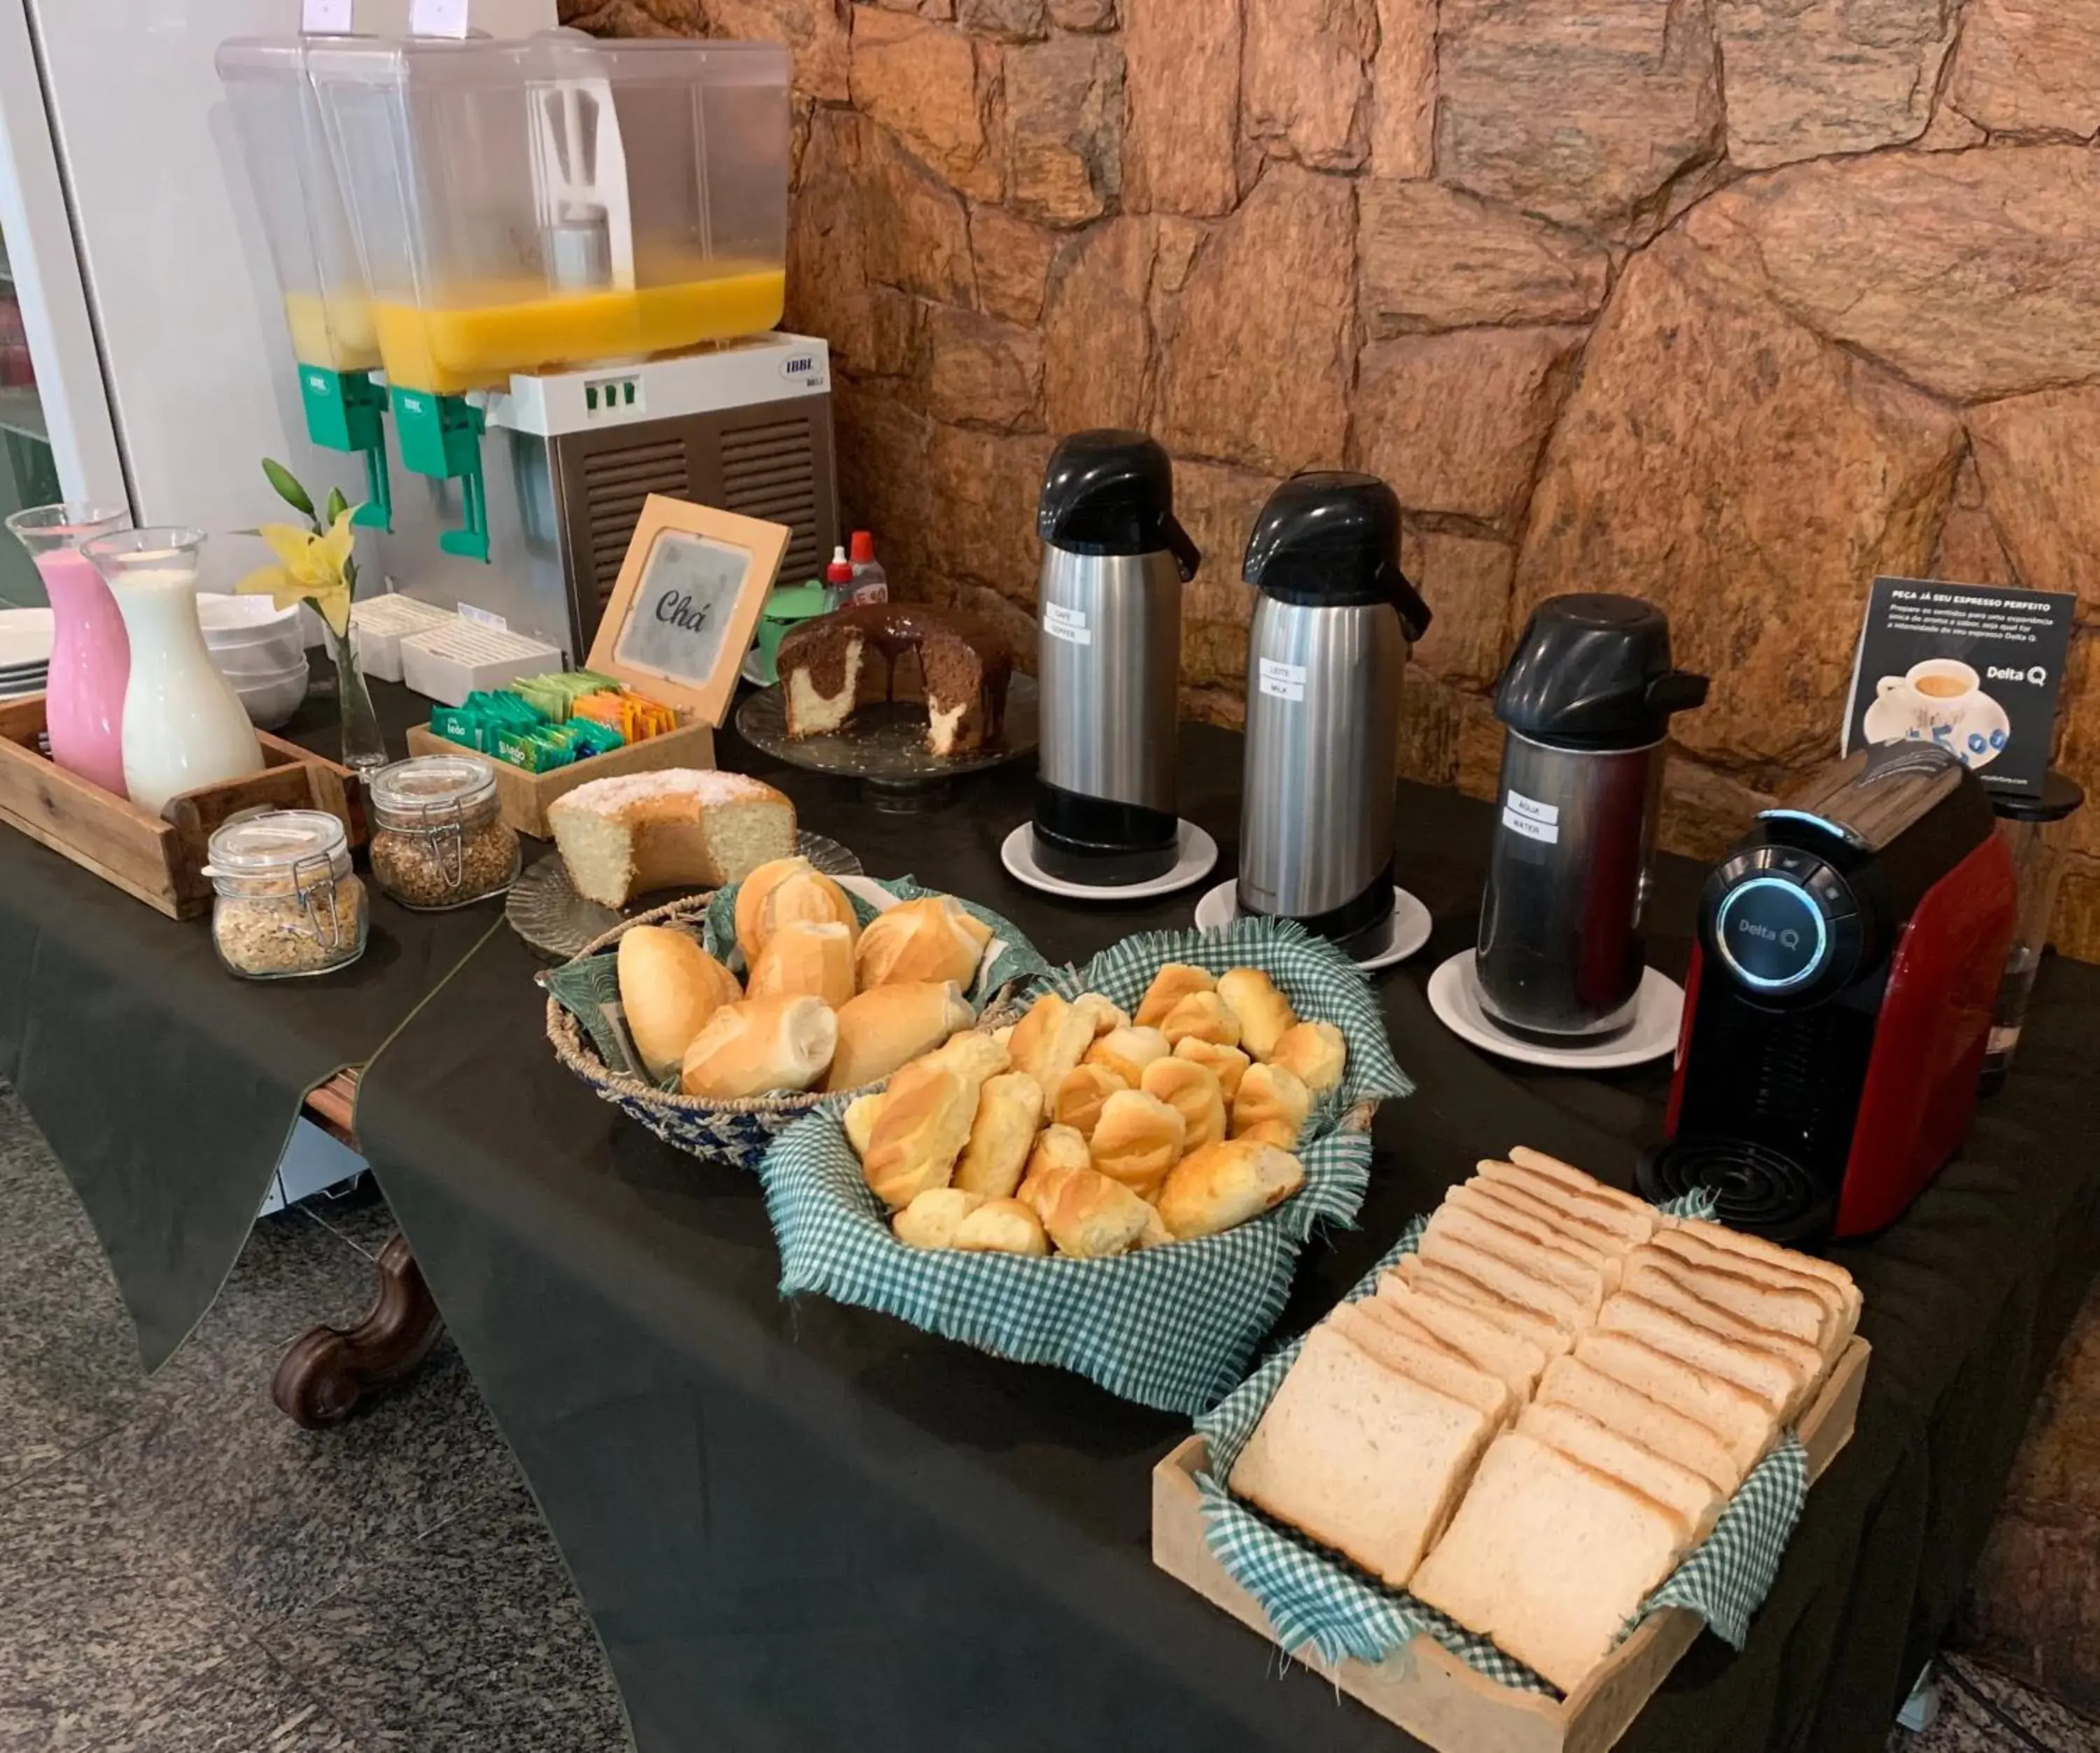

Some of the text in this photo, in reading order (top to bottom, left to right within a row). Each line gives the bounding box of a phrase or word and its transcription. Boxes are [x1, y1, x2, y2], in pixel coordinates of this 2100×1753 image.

[785, 358, 813, 374] IBBL
[655, 589, 711, 634] Chá
[1891, 590, 1917, 601] PEÇA
[1933, 594, 1952, 603] SEU
[1953, 595, 2003, 608] ESPRESSO
[2003, 600, 2051, 612] PERFEITO
[1986, 666, 2047, 687] Delta Q
[1513, 819, 1539, 834] WATER
[1739, 919, 1799, 951] Delta Q
